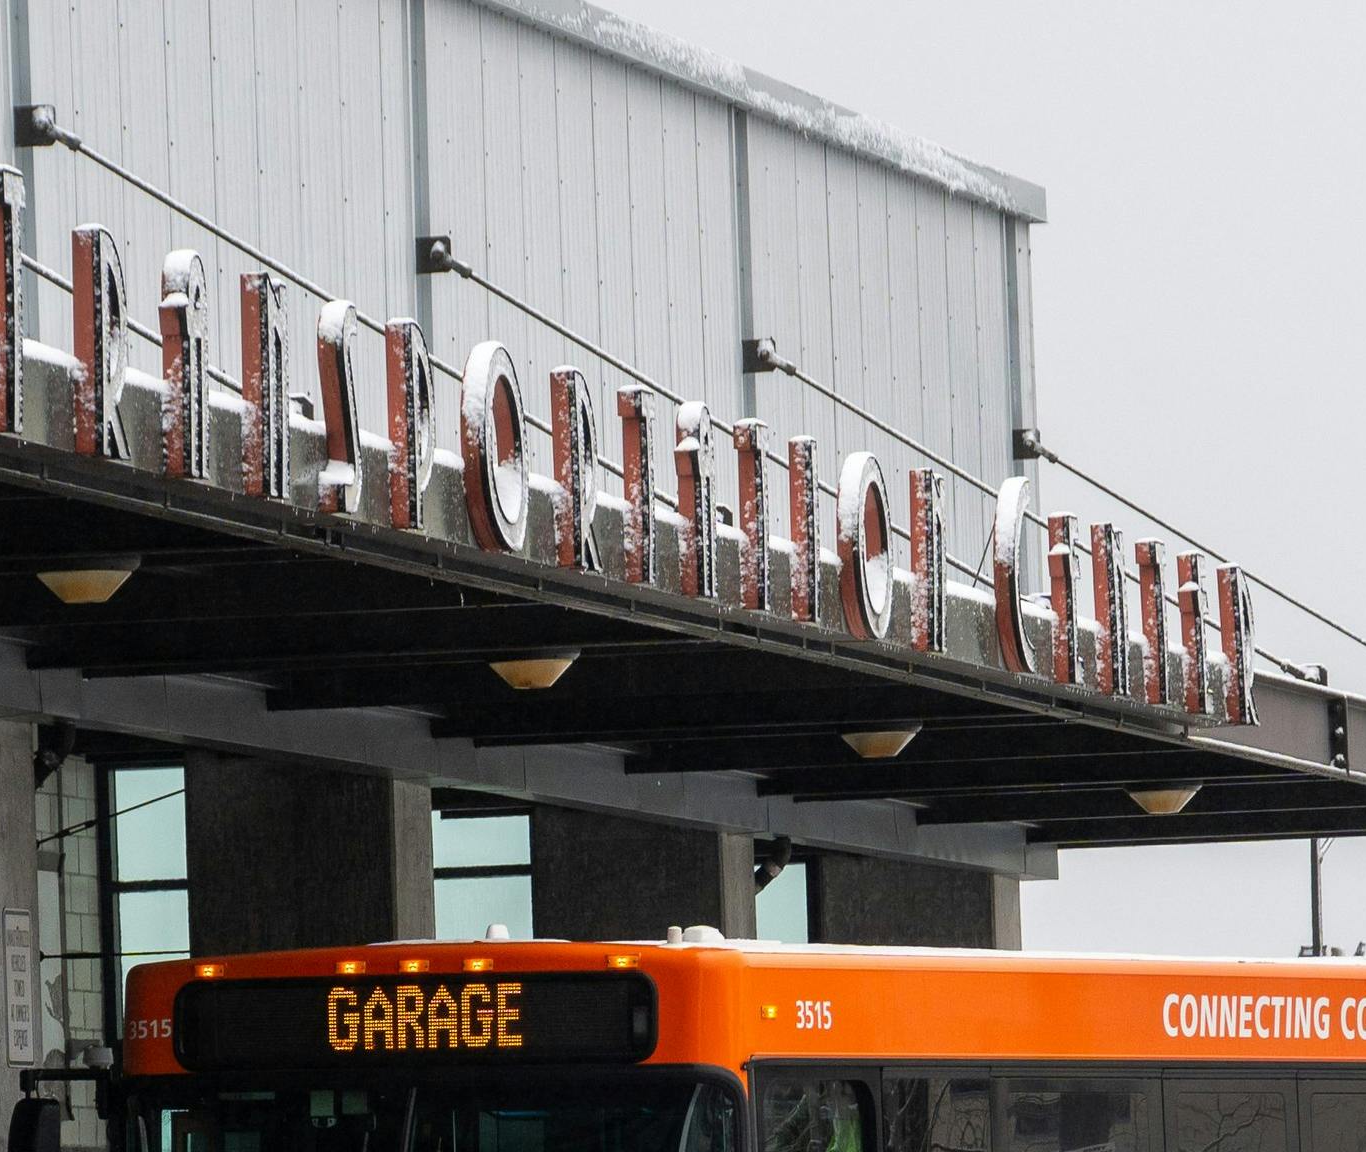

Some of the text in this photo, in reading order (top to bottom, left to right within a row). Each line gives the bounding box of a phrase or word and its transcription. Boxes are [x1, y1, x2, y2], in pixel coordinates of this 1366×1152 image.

[992, 475, 1261, 727] CENTER
[128, 1018, 172, 1040] 3515
[328, 983, 523, 1050] GARAGE
[795, 999, 832, 1030] 3515
[1162, 993, 1330, 1039] CONNECTING
